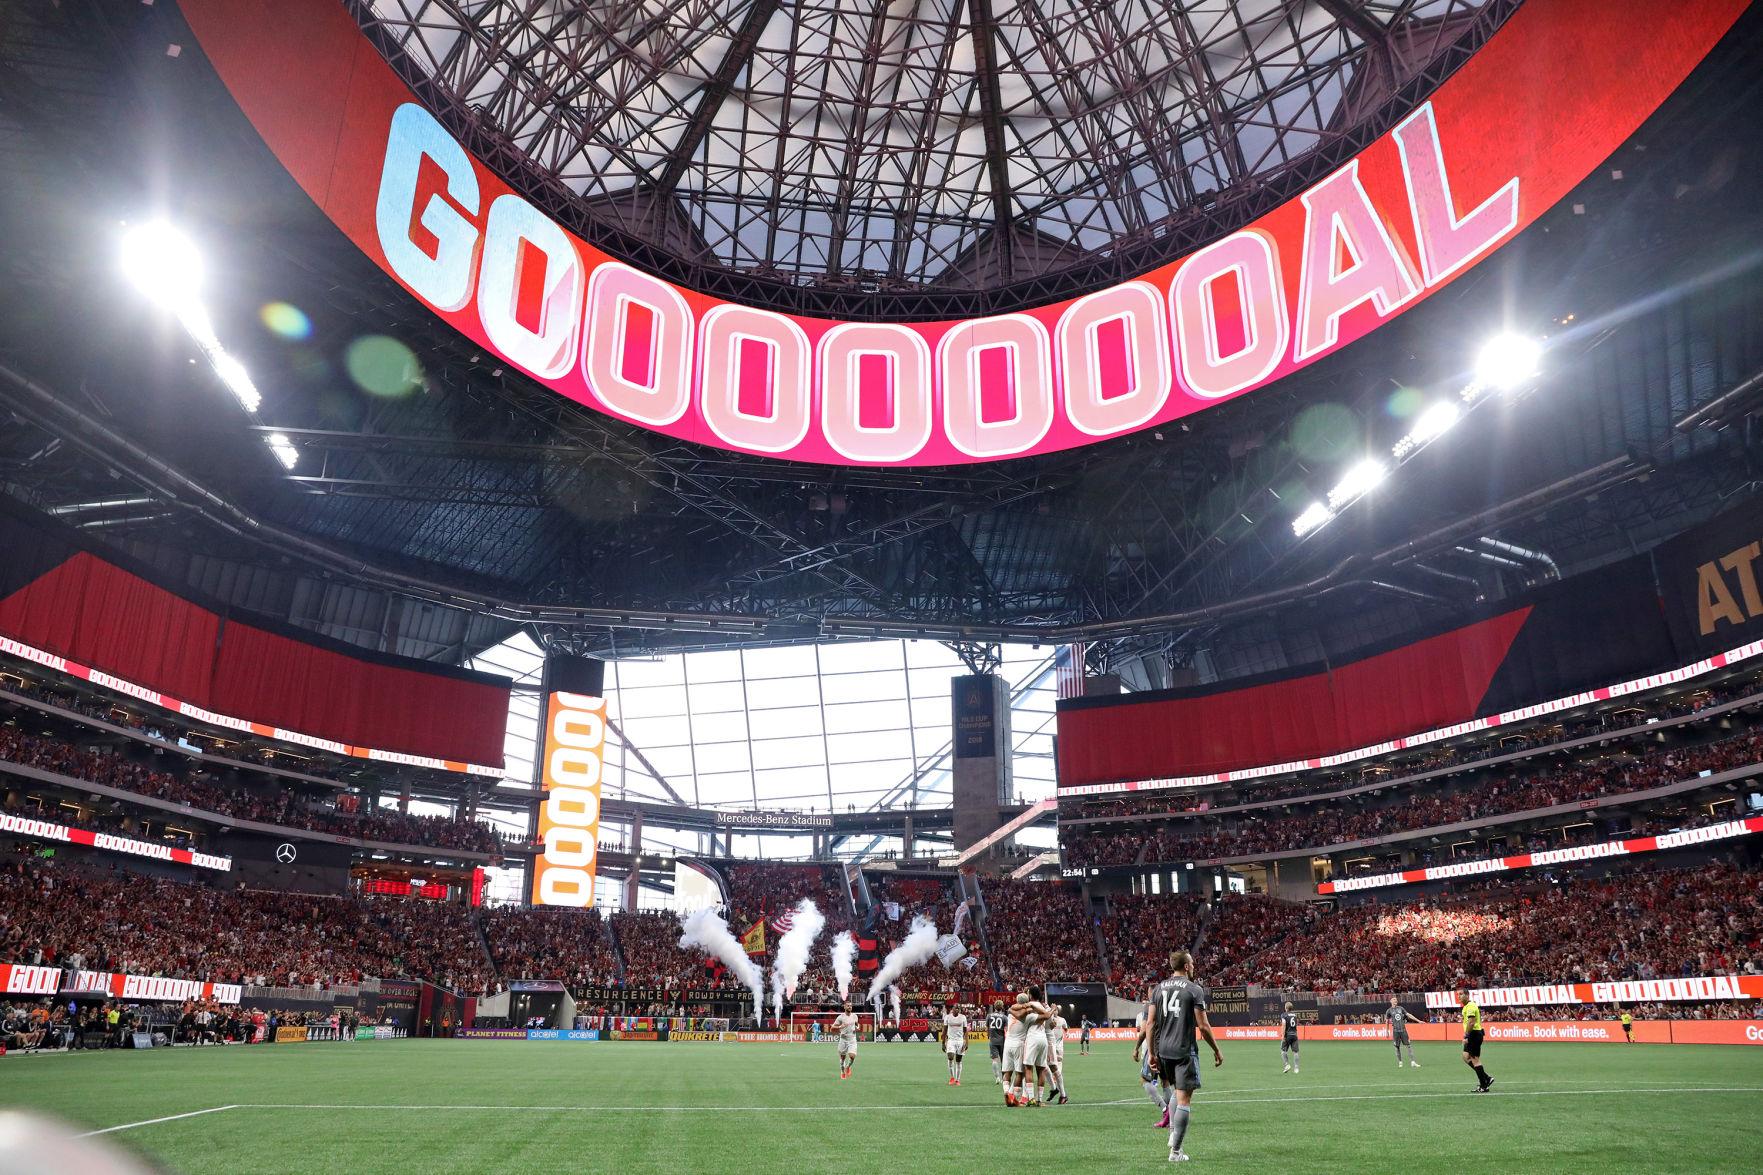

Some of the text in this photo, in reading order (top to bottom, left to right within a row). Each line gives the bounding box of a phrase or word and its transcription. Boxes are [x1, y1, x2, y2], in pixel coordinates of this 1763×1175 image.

[376, 102, 1520, 463] GOOOOOOOAL
[717, 813, 831, 825] Mercedes-Benz Stadium
[1592, 976, 1750, 1002] GOOOOOOOAL
[577, 989, 662, 1000] RESURGENCE
[688, 991, 721, 1000] ROWDY
[737, 992, 753, 1001] PRO
[928, 992, 956, 1001] LEGION
[1162, 990, 1181, 1018] 14
[1206, 1003, 1229, 1013] LANTA
[989, 1016, 1003, 1029] 20
[1289, 1017, 1296, 1027] 6
[669, 1032, 719, 1041] QUIKRETE
[740, 1033, 755, 1041] THE
[757, 1033, 779, 1041] HOME
[780, 1033, 804, 1041] DEPOT
[811, 1033, 841, 1042] Heine
[1094, 1030, 1114, 1039] Book
[1117, 1030, 1135, 1039] with
[1226, 1029, 1233, 1038] Go
[1333, 1028, 1341, 1038] Go
[1342, 1028, 1360, 1038] online.
[1361, 1028, 1377, 1038] Book
[1490, 1027, 1609, 1039] Go online. Book with ease.
